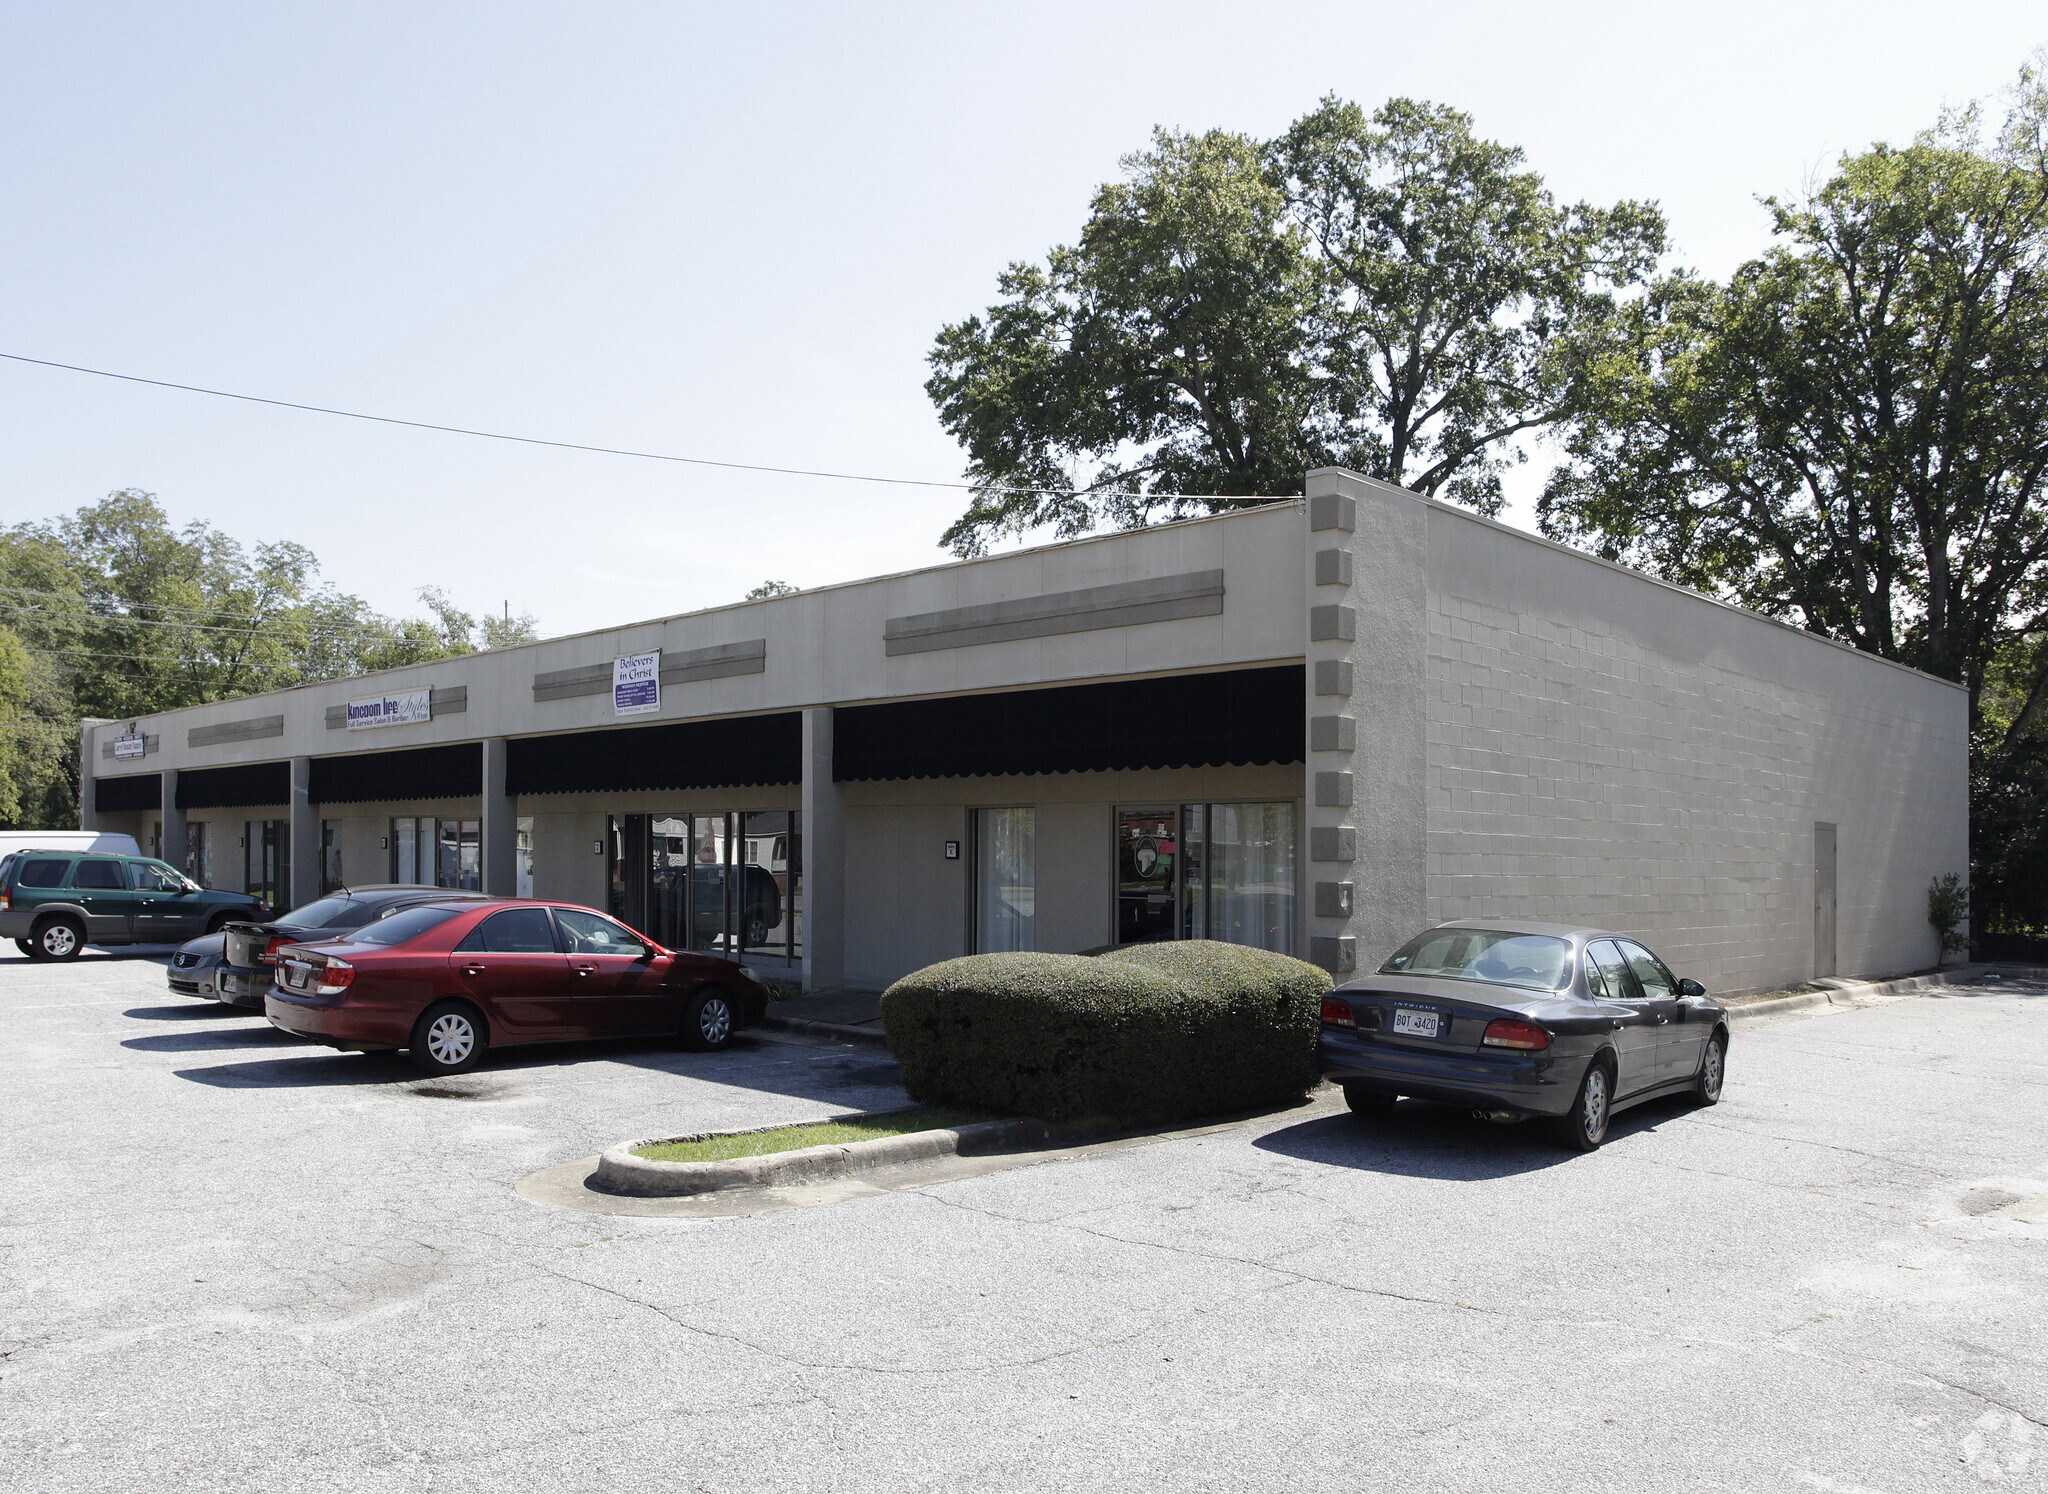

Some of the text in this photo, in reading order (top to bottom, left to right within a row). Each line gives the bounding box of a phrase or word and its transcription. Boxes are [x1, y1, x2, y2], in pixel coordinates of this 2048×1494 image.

[620, 656, 653, 669] Believers
[619, 668, 652, 680] in Christ
[347, 720, 356, 728] Full
[356, 719, 373, 727] Service
[374, 717, 387, 725] Salon
[391, 714, 409, 722] Barber
[1394, 1001, 1437, 1011] INTRIGUE
[1396, 1014, 1436, 1030] BQT 3420
